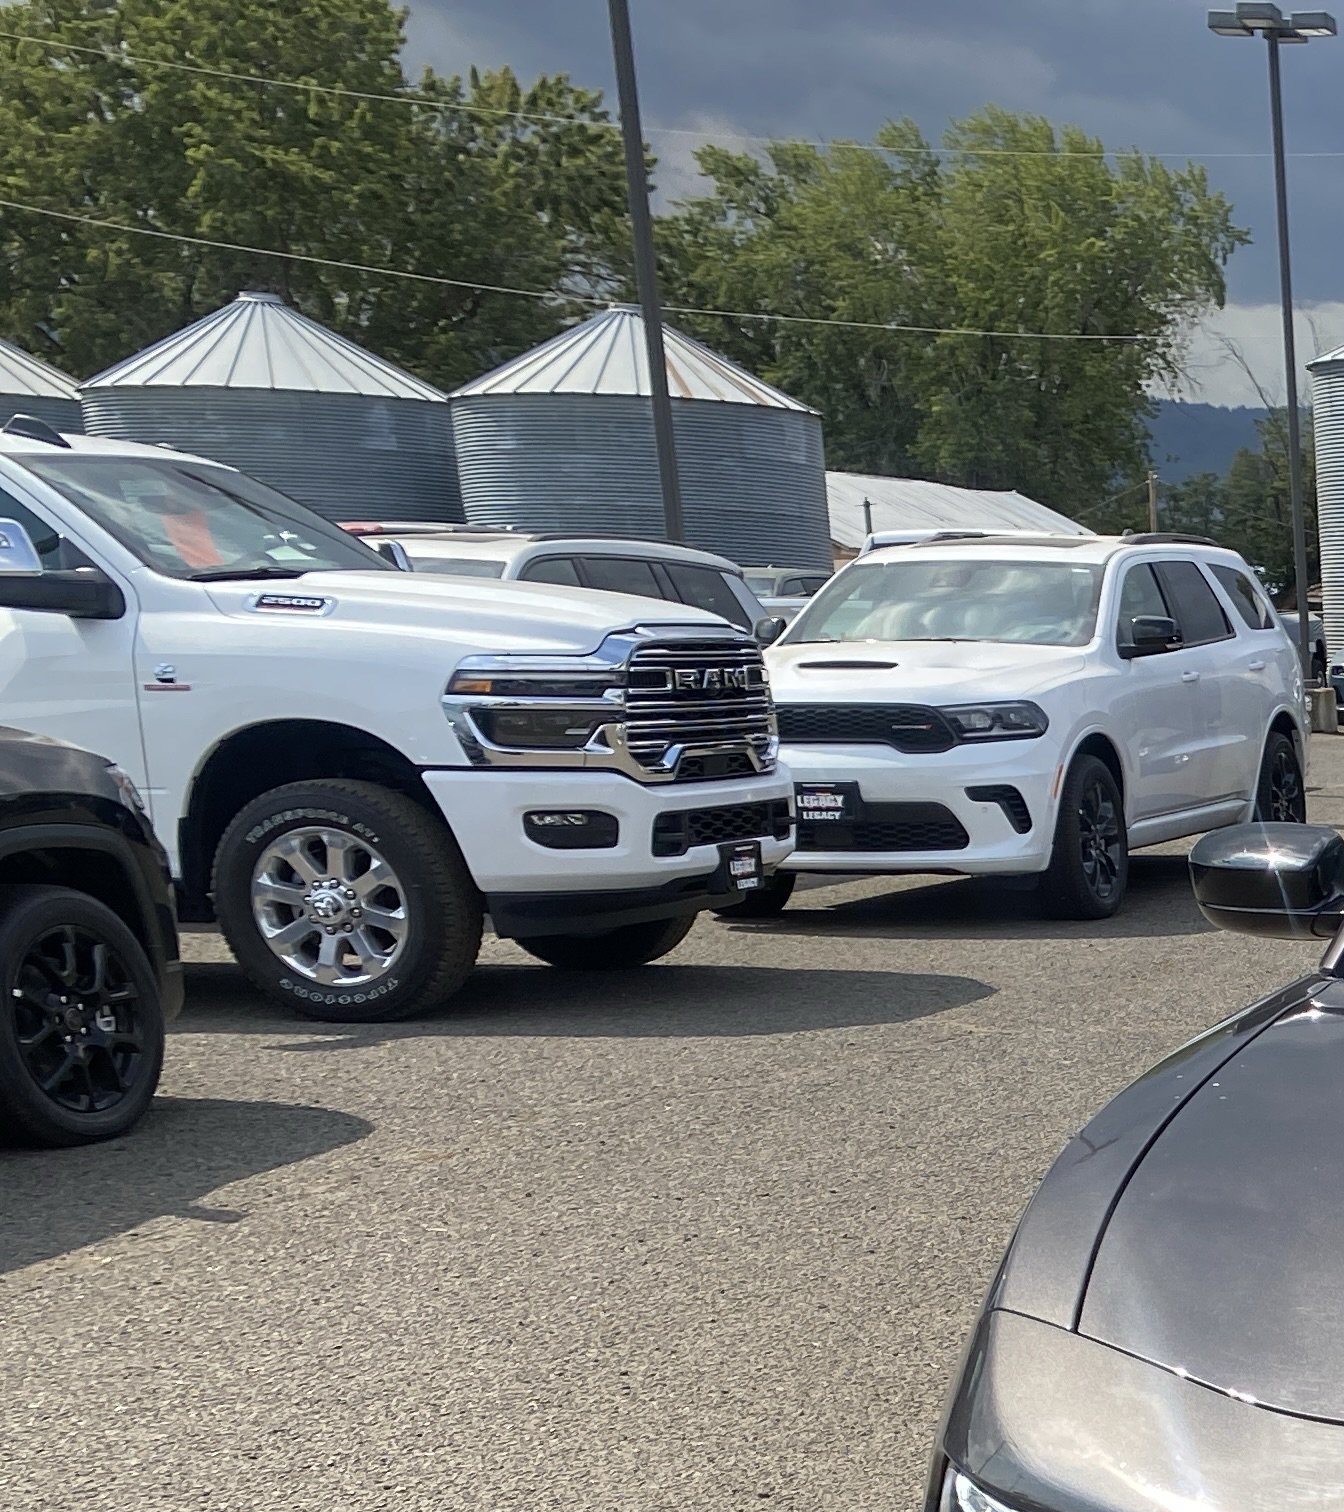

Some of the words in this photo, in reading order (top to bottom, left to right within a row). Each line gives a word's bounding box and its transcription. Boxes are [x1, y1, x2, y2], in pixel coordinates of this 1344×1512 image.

[261, 596, 322, 607] 2500
[674, 668, 746, 690] RAM
[796, 795, 845, 807] LEGACY
[802, 811, 842, 820] LEGACY
